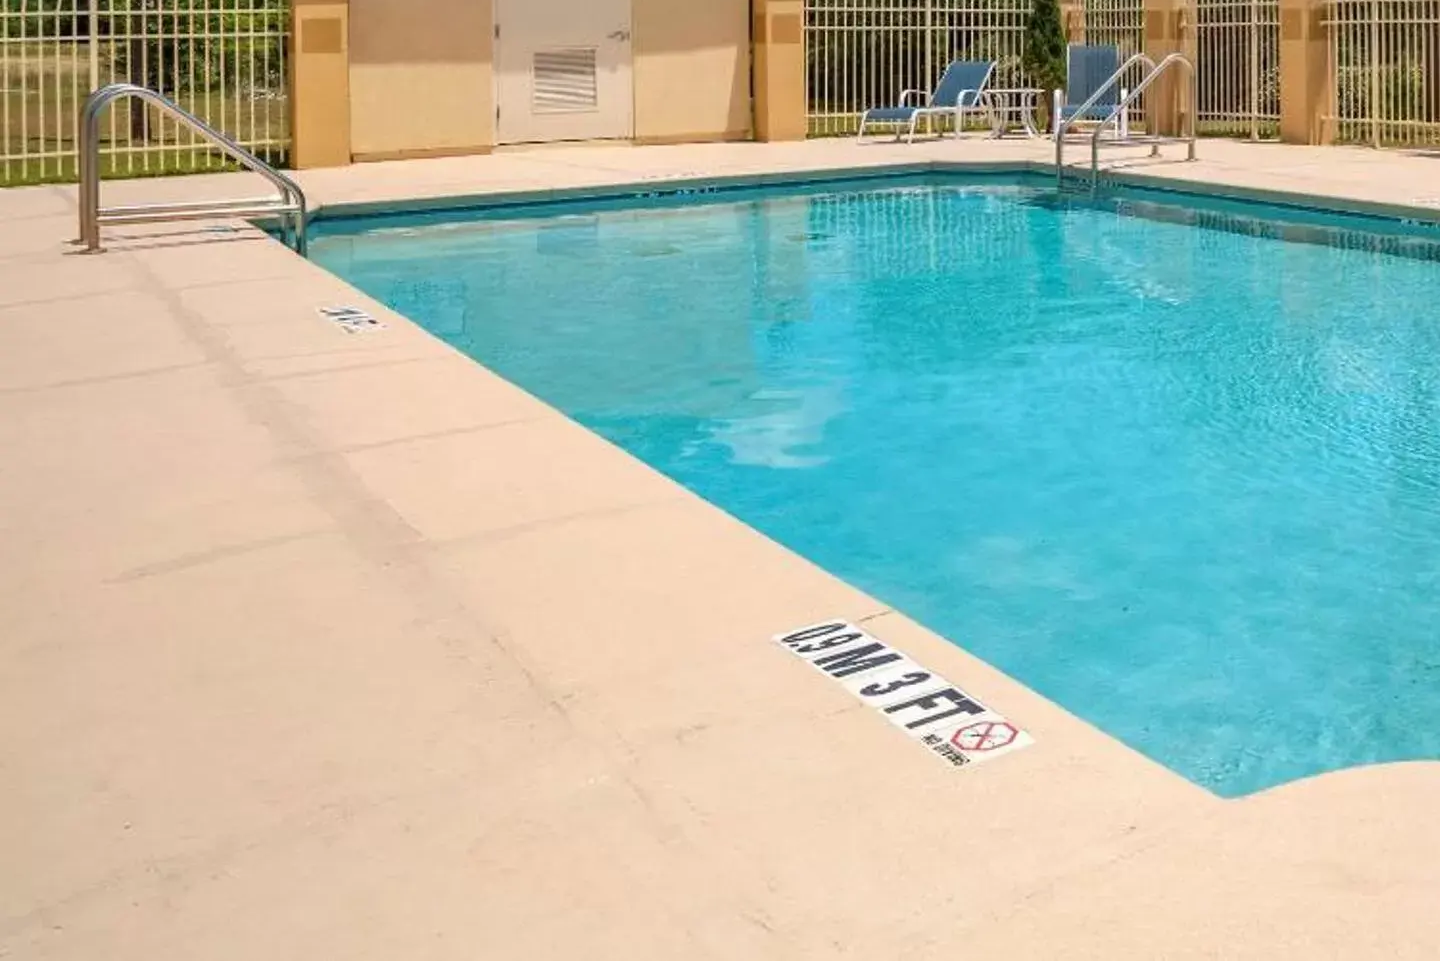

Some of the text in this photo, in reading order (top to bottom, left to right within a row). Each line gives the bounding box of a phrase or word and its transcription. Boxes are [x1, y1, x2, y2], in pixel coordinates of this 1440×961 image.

[781, 622, 986, 730] 0.9 M 3 FT
